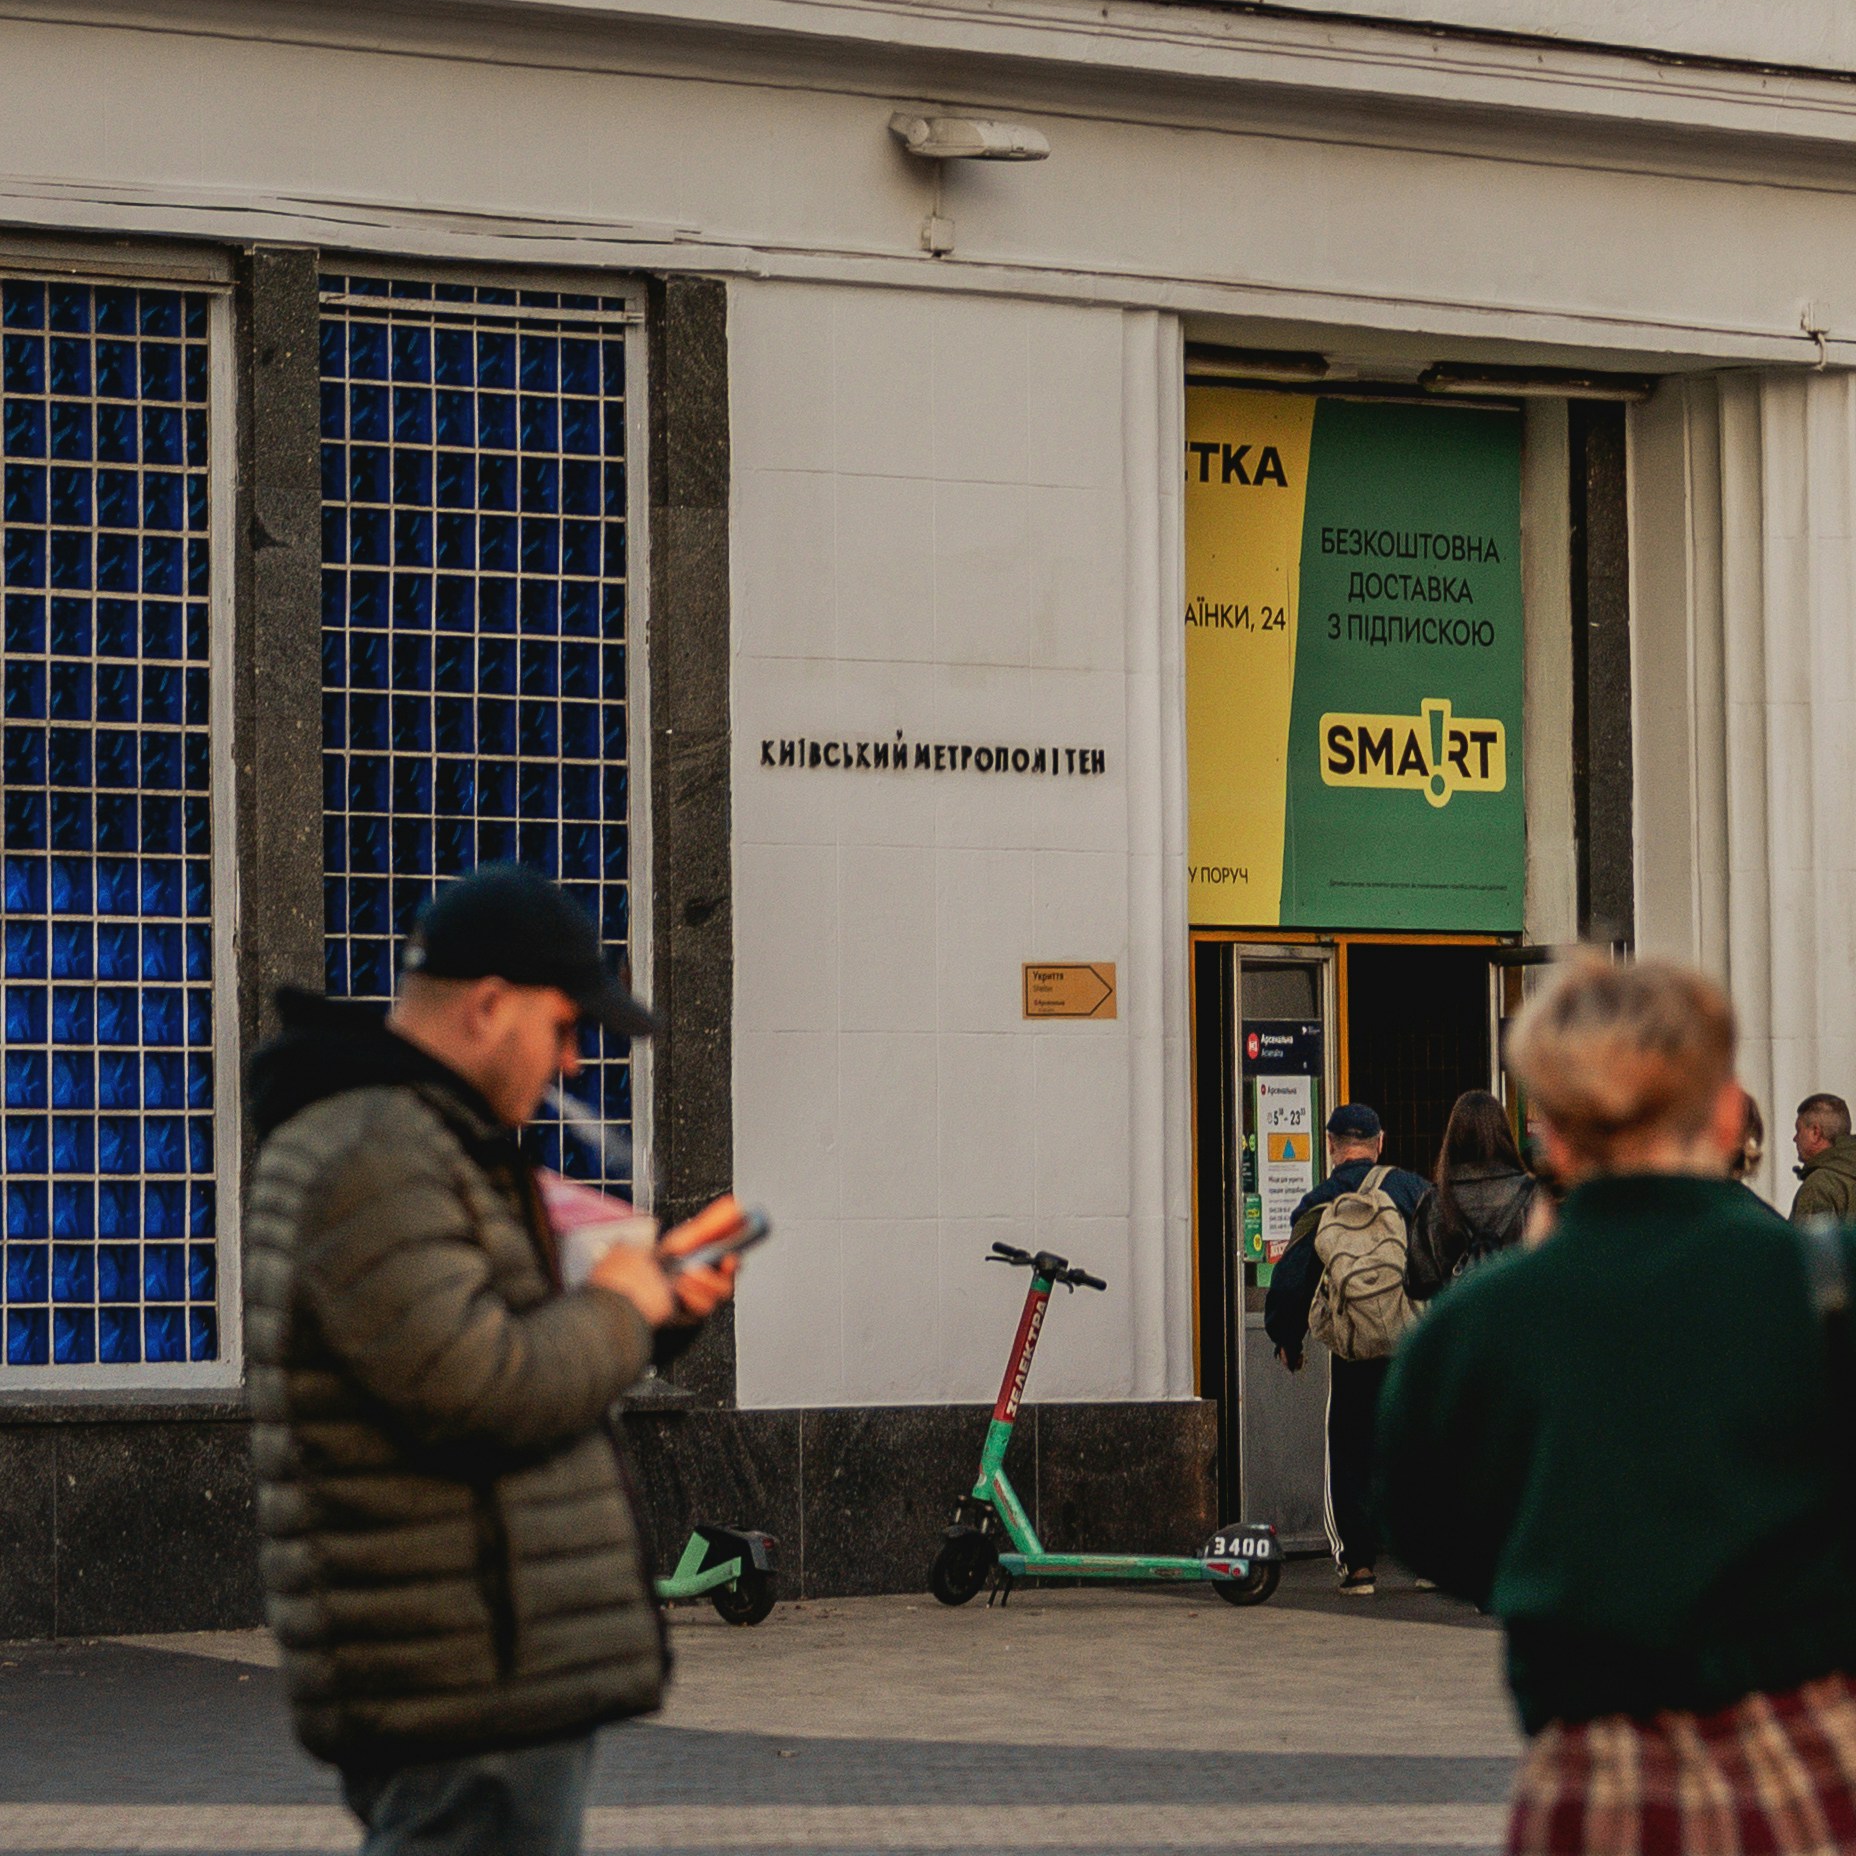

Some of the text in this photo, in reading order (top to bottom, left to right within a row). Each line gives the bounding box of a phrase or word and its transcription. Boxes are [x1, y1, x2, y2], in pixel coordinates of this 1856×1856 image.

[1185, 441, 1288, 487] ТКА
[1321, 527, 1500, 563] БЕЗКОШТОВНА
[1348, 572, 1473, 604] ДОСТАВКА
[1185, 596, 1286, 633] АЇНКИ, 24
[1328, 613, 1495, 647] З ПІДПИСКОЮ
[760, 729, 1106, 776] КИЇВСЬКИЙ МЕТРОПОЛІТЕН
[1200, 866, 1249, 885] ПОРУЧ
[1033, 971, 1064, 983] Укриття
[1213, 1536, 1270, 1558] 3400
